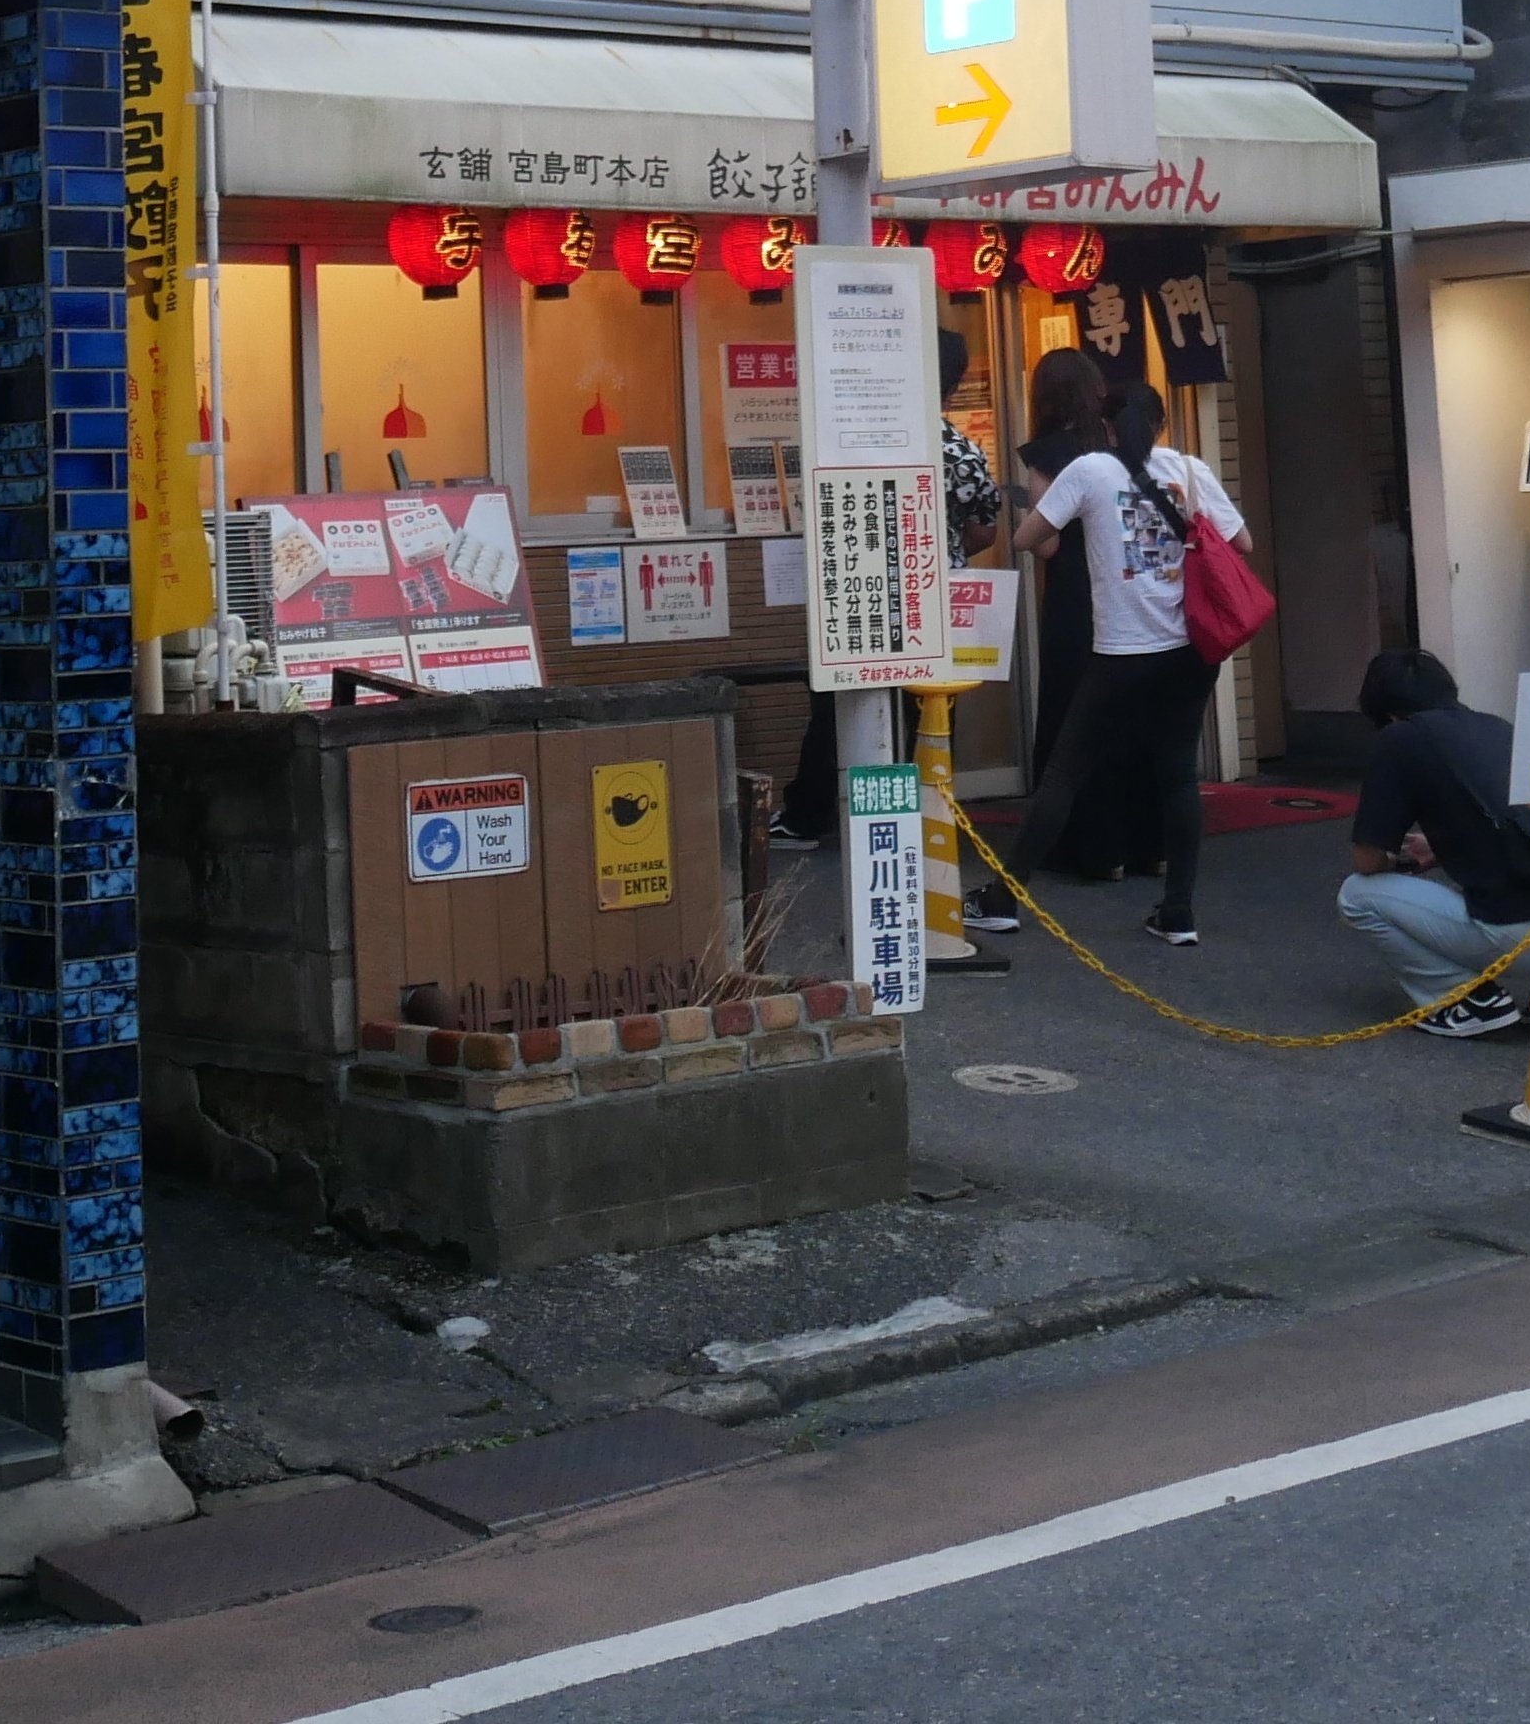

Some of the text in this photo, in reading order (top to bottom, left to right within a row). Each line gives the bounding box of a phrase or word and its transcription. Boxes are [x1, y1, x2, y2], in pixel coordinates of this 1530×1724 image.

[508, 149, 670, 188] 宮島町本店
[736, 353, 796, 380] 営業中
[917, 474, 936, 590] 宮パーキング
[820, 482, 841, 653] 駐車券を持参下さい
[902, 495, 923, 646] ご利用のお客様へ
[844, 576, 863, 655] 20分無料
[865, 576, 884, 653] 60分無料
[859, 664, 934, 683] 宇都宮みんみん
[434, 783, 519, 807] WARNING
[476, 814, 512, 829] Wash
[477, 832, 507, 848] Your
[479, 849, 512, 866] Hand
[617, 862, 639, 874] FACE
[624, 876, 668, 896] ENTER
[868, 821, 903, 1007] 岡川駐車場
